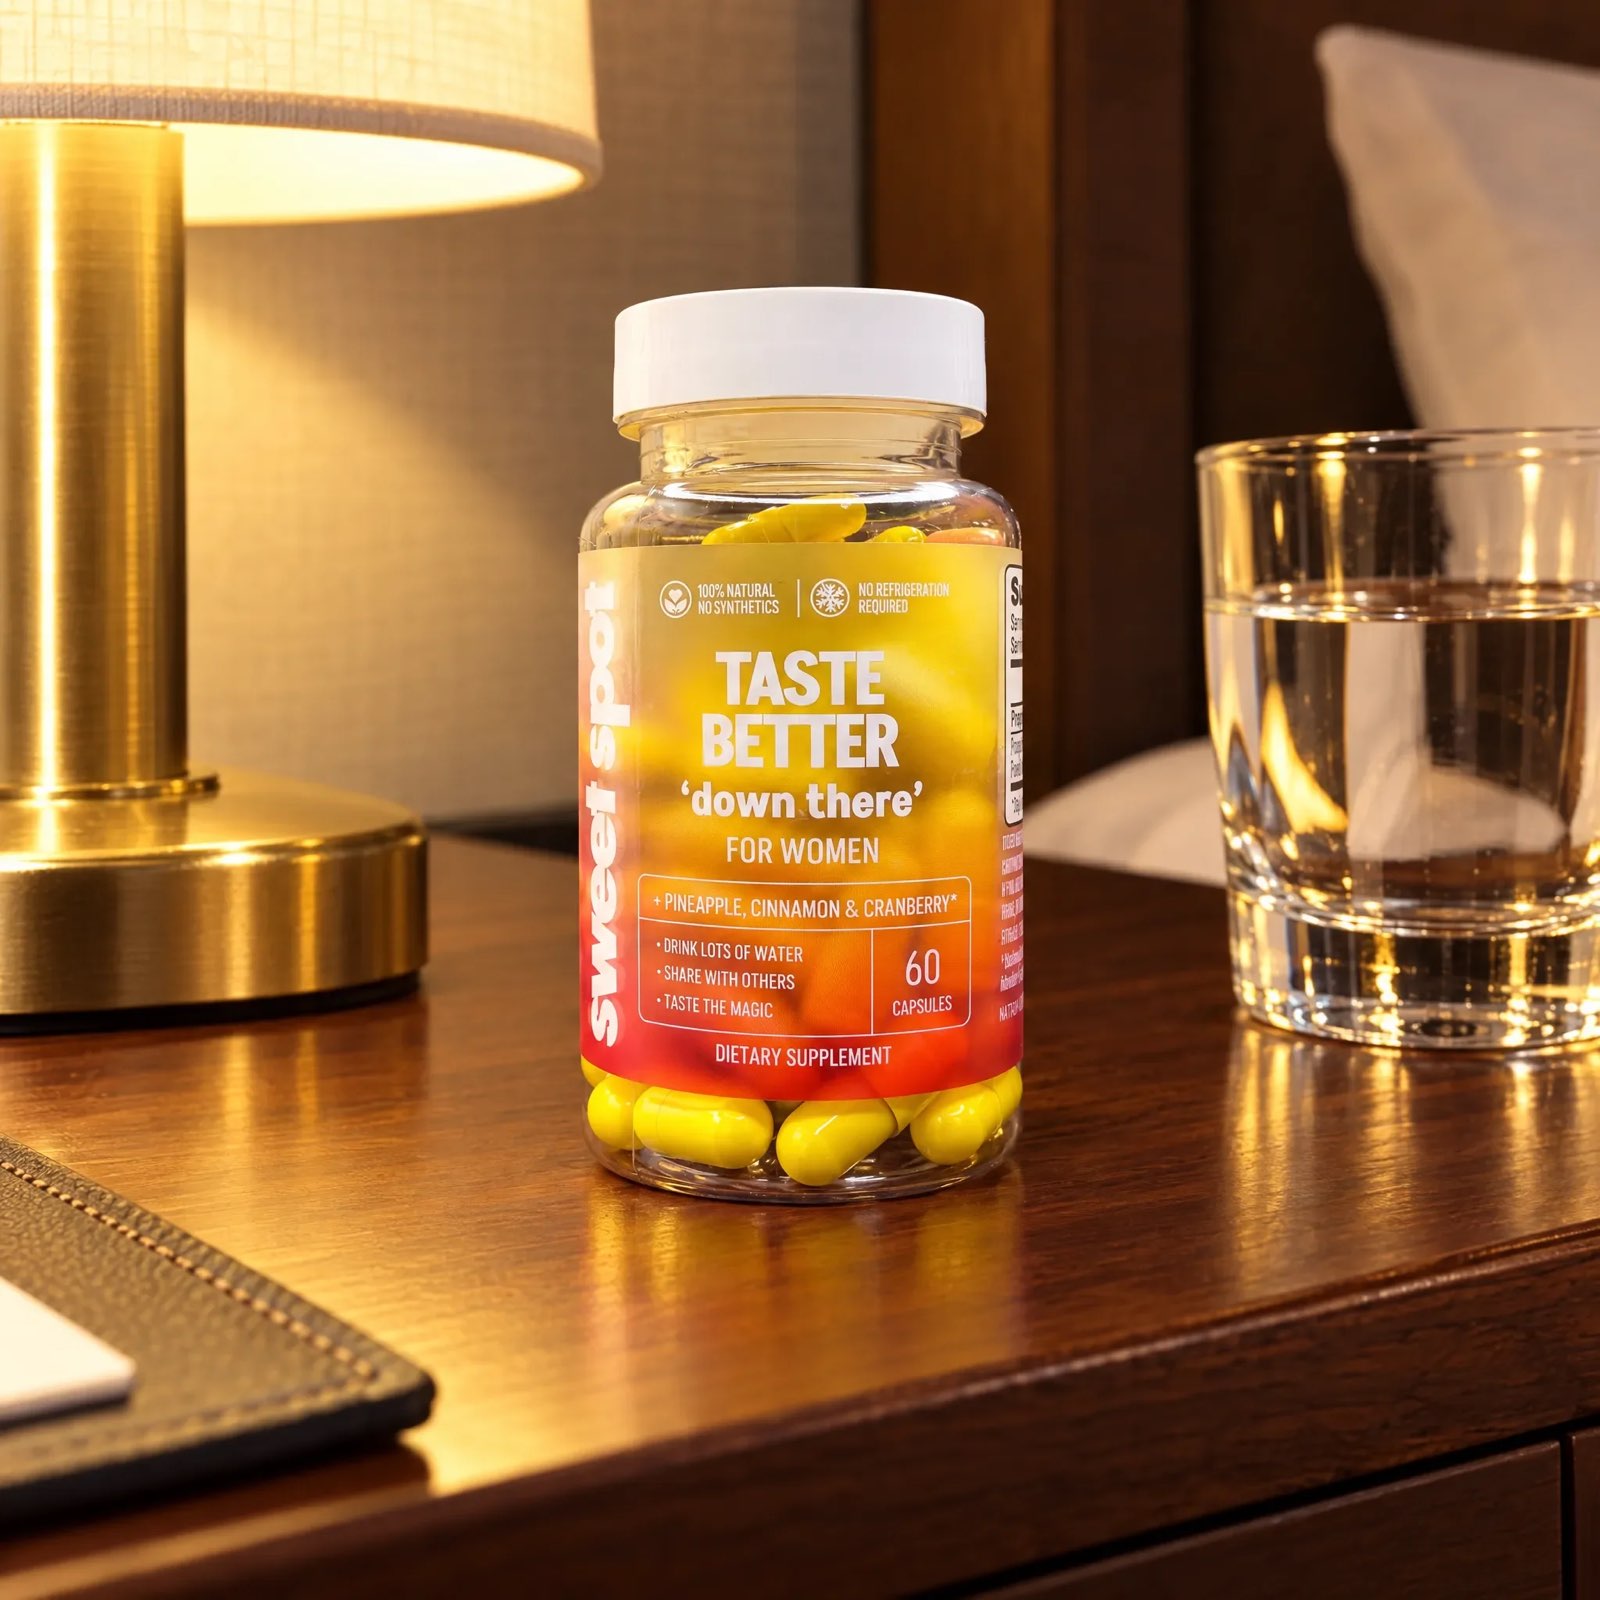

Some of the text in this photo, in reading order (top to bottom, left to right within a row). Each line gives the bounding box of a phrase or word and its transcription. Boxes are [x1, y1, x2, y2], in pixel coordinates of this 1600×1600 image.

[697, 583, 775, 598] 100% NATURAL
[858, 582, 950, 597] NO REFRIGERATION
[697, 600, 779, 615] NO SYNTHETICS
[858, 599, 909, 615] REQUIRED
[715, 650, 885, 706] TASTE
[701, 713, 900, 769] BETTER
[584, 580, 631, 1048] sweet spot
[726, 836, 880, 865] FOR WOMEN
[653, 895, 661, 906] +
[664, 892, 747, 920] PINEAPPLE,
[750, 898, 841, 919] CINNAMON
[845, 899, 860, 918] &
[663, 937, 804, 963] DRINK LOTS OF WATER
[664, 965, 796, 990] SHARE WITH OTHERS
[905, 948, 941, 986] 60
[663, 993, 774, 1019] TASTE THE MAGIC
[892, 995, 953, 1017] CAPSULES
[715, 1043, 893, 1067] DIETARY SUPPLEMENT
